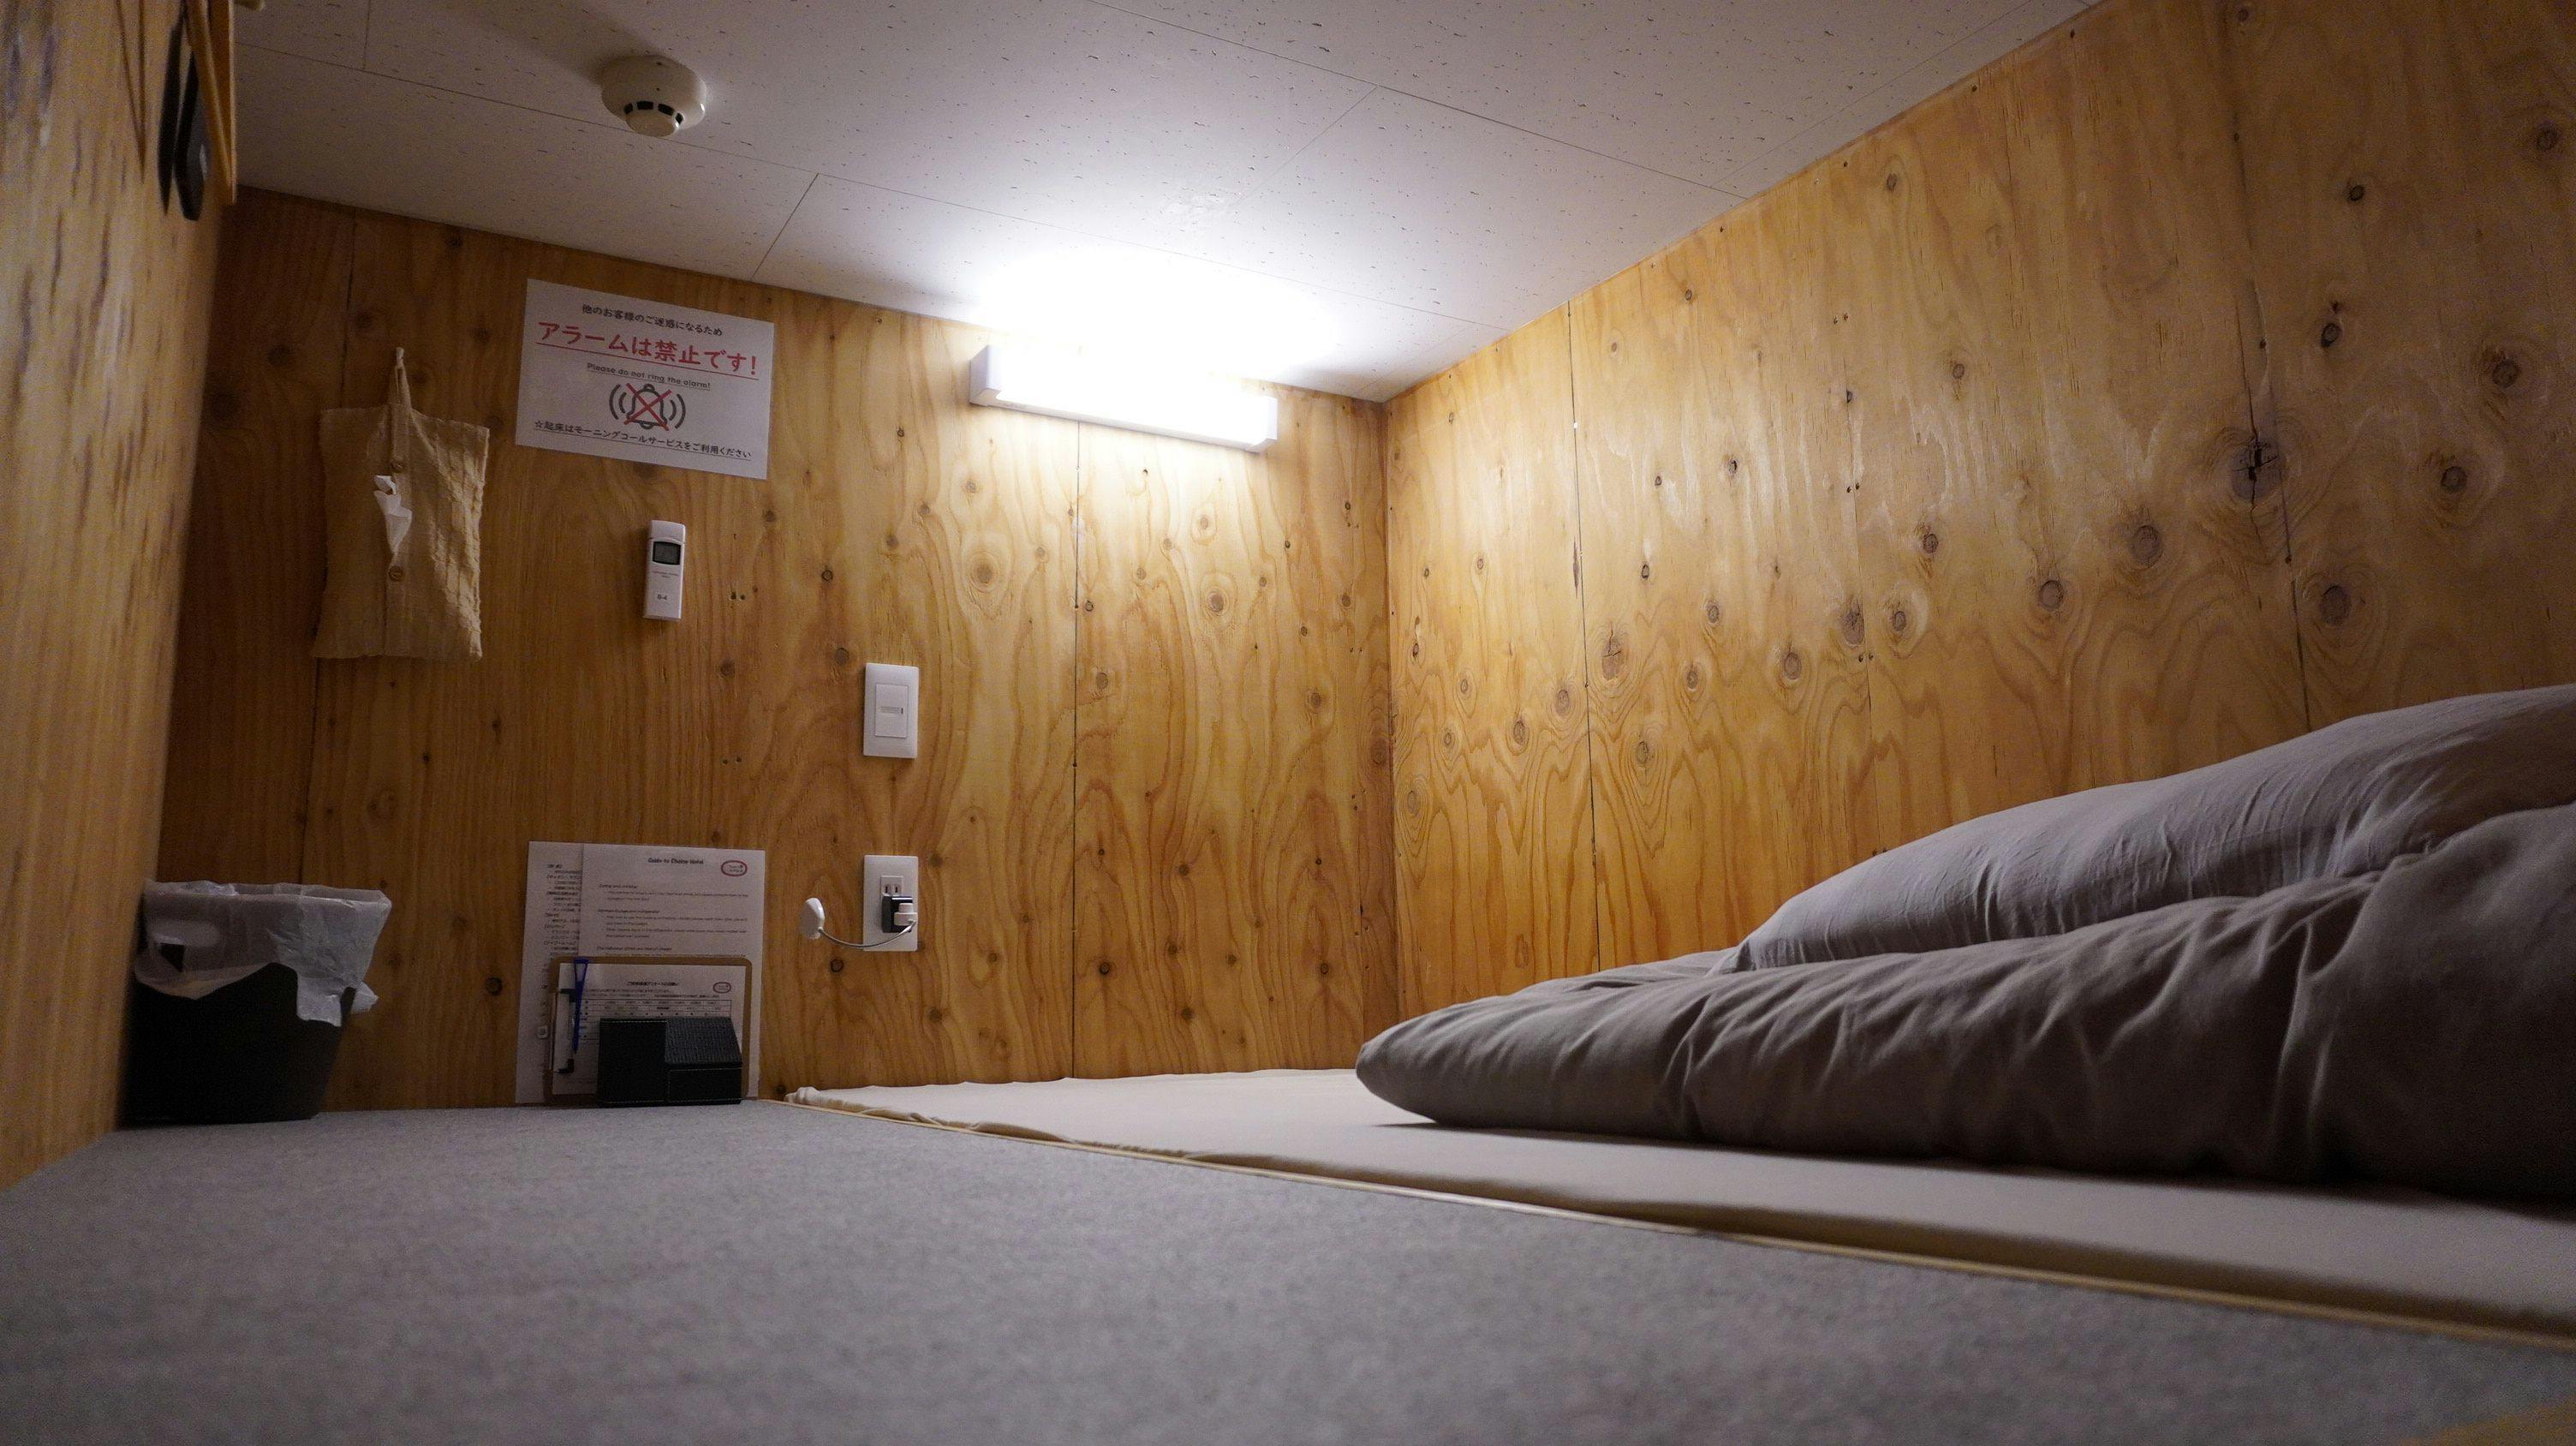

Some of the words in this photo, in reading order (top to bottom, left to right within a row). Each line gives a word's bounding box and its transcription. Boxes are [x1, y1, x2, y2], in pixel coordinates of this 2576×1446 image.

[587, 362, 616, 373] Please
[647, 373, 665, 383] ring
[683, 379, 711, 389] alarm!
